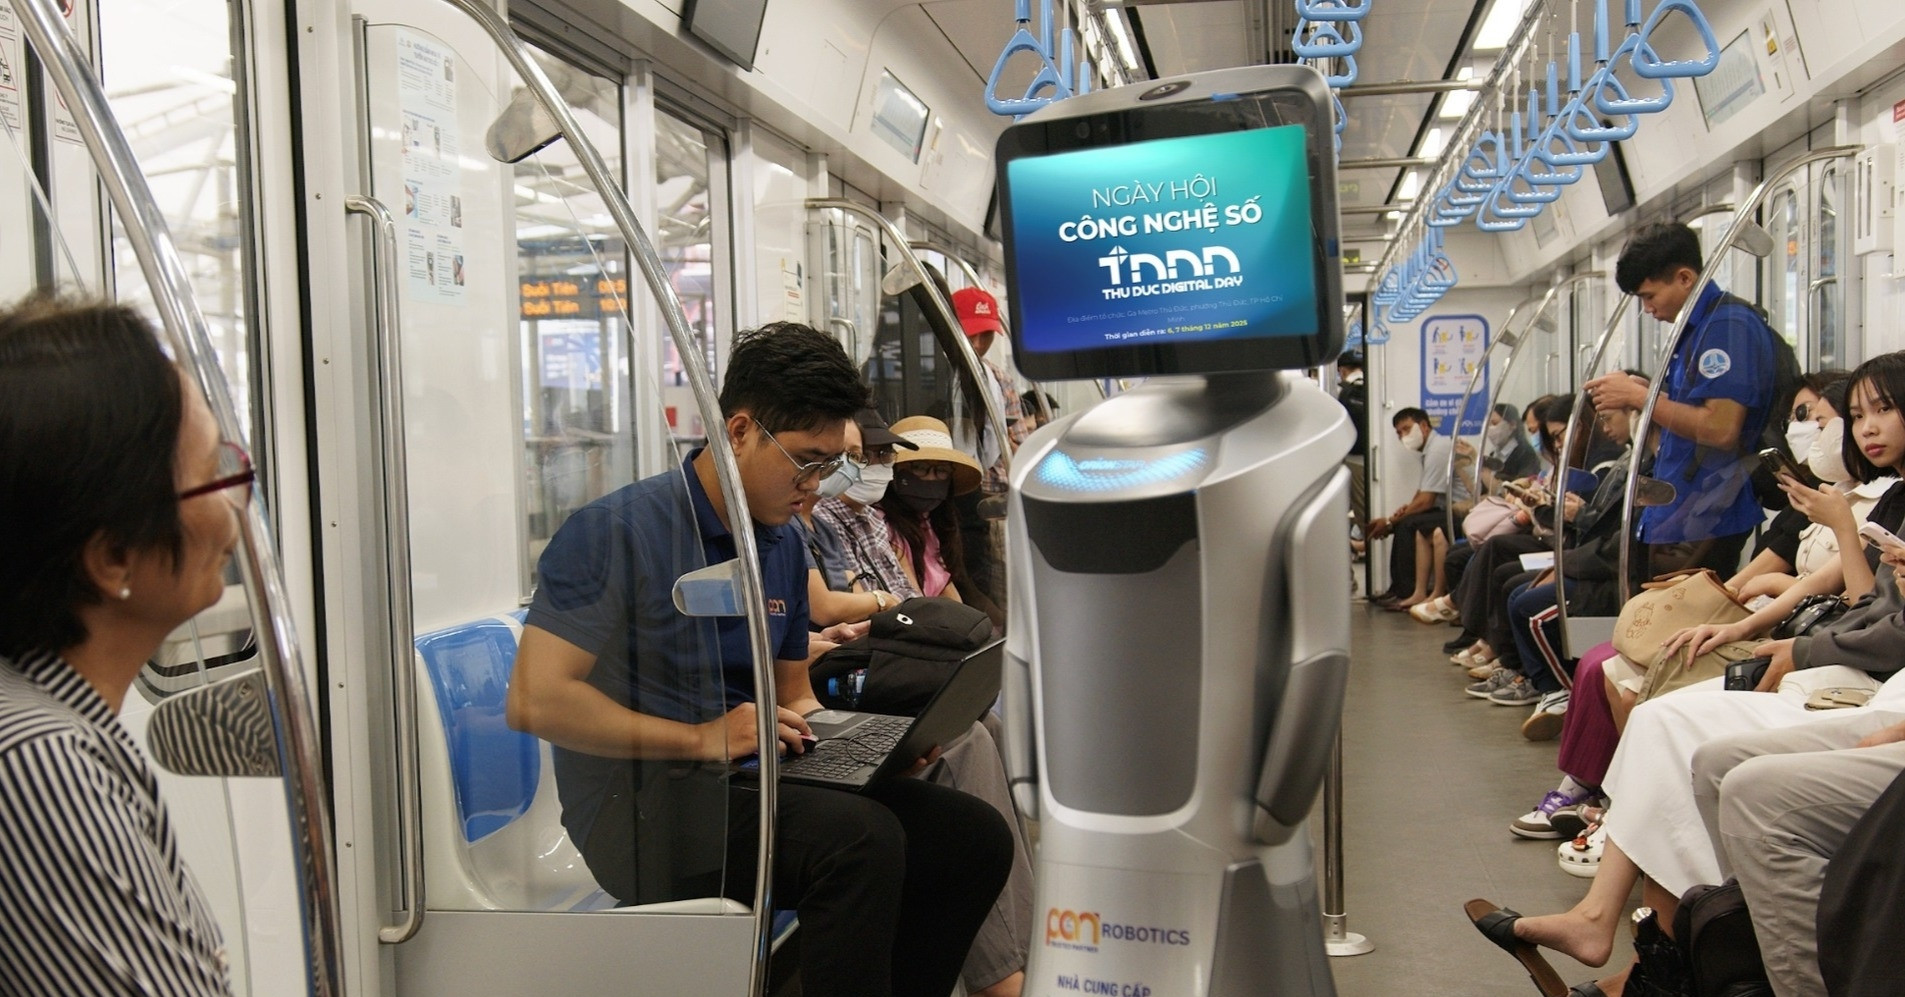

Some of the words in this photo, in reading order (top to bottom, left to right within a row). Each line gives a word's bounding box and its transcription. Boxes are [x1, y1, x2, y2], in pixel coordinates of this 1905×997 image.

[1092, 180, 1165, 208] NGÀY
[1170, 173, 1218, 203] HỘI
[1058, 214, 1138, 243] CÔNG
[1143, 202, 1220, 234] NGHỆ
[1224, 195, 1263, 226] SỐ
[1102, 287, 1131, 300] THU
[1131, 284, 1161, 298] DUC
[1161, 279, 1213, 294] DIGITAL
[1214, 275, 1244, 290] DAY
[1104, 332, 1121, 340] Thời
[1121, 331, 1139, 340] gian
[1181, 324, 1204, 332] tháng
[1212, 321, 1230, 329] năm
[1230, 319, 1248, 327] 2025
[1102, 923, 1191, 946] ROBOTICS
[1057, 974, 1080, 991] NHÀ
[1084, 979, 1119, 997] CUNG
[1122, 981, 1151, 997] CẤP
